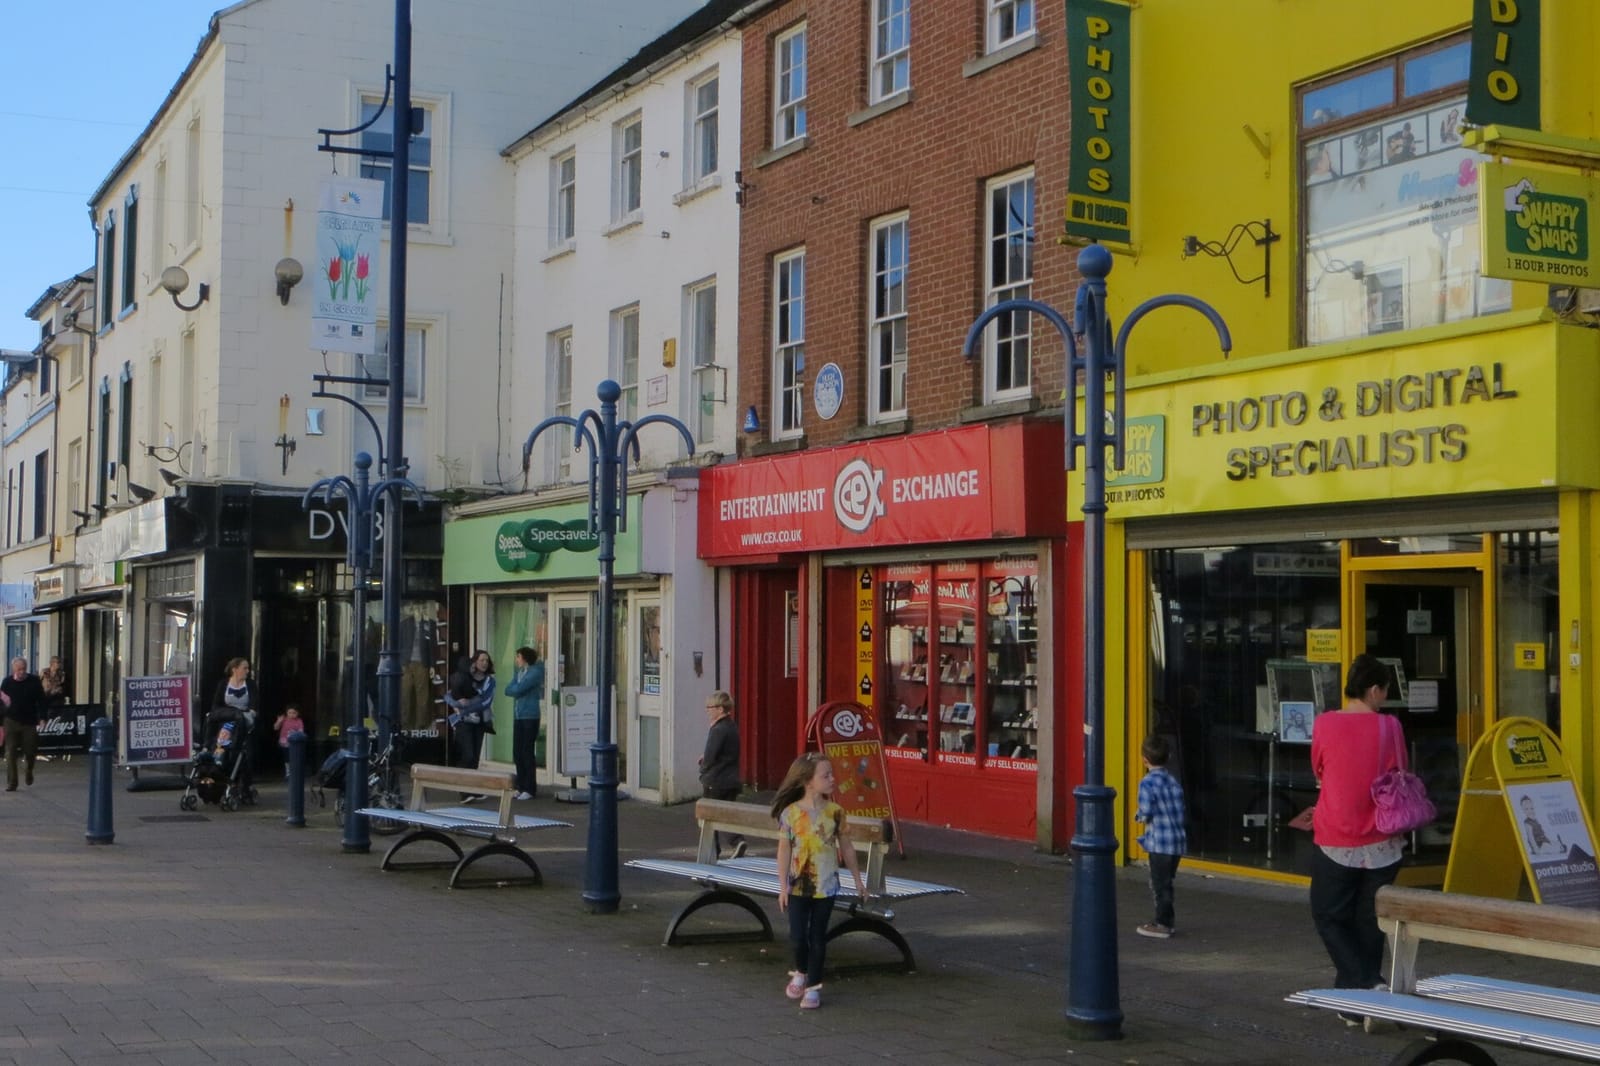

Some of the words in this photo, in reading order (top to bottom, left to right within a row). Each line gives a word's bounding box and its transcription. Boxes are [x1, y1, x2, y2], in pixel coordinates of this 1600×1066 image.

[1086, 16, 1112, 192] PHOTOS
[1516, 194, 1579, 230] SNAPPY
[1526, 224, 1578, 254] SNAPS
[1507, 258, 1511, 269] 1
[1515, 258, 1544, 273] HOUR
[1547, 262, 1589, 277] PHOTOS
[1192, 390, 1308, 437] PHOTO
[1318, 387, 1343, 422] &
[1356, 362, 1517, 418] DIGITAL
[1226, 424, 1468, 482] SPECIALISTS
[892, 470, 979, 503] EXCHANGE
[1104, 491, 1124, 503] OUR
[1125, 487, 1165, 502] PHOTOS
[720, 488, 826, 521] ENTERTAINMENT
[531, 528, 598, 543] Specsavers
[741, 530, 801, 546] WWW.CEX.CO.UK
[129, 680, 182, 689] CHRISTMAS
[144, 689, 169, 698] CLUB
[132, 698, 180, 708] FACILITIES
[131, 707, 182, 717] AVAILABLE
[136, 720, 177, 729] DEPOSIT
[134, 728, 180, 738] SECURES
[135, 739, 155, 747] ANY
[158, 737, 180, 746] ITEM
[147, 749, 168, 759] DV8
[828, 745, 849, 758] WE
[853, 744, 878, 756] BUY
[945, 755, 976, 765] RECYCLING
[997, 760, 1012, 769] SELL
[846, 806, 891, 818] HONES
[1536, 863, 1570, 880] portrait
[1570, 861, 1596, 873] studio
